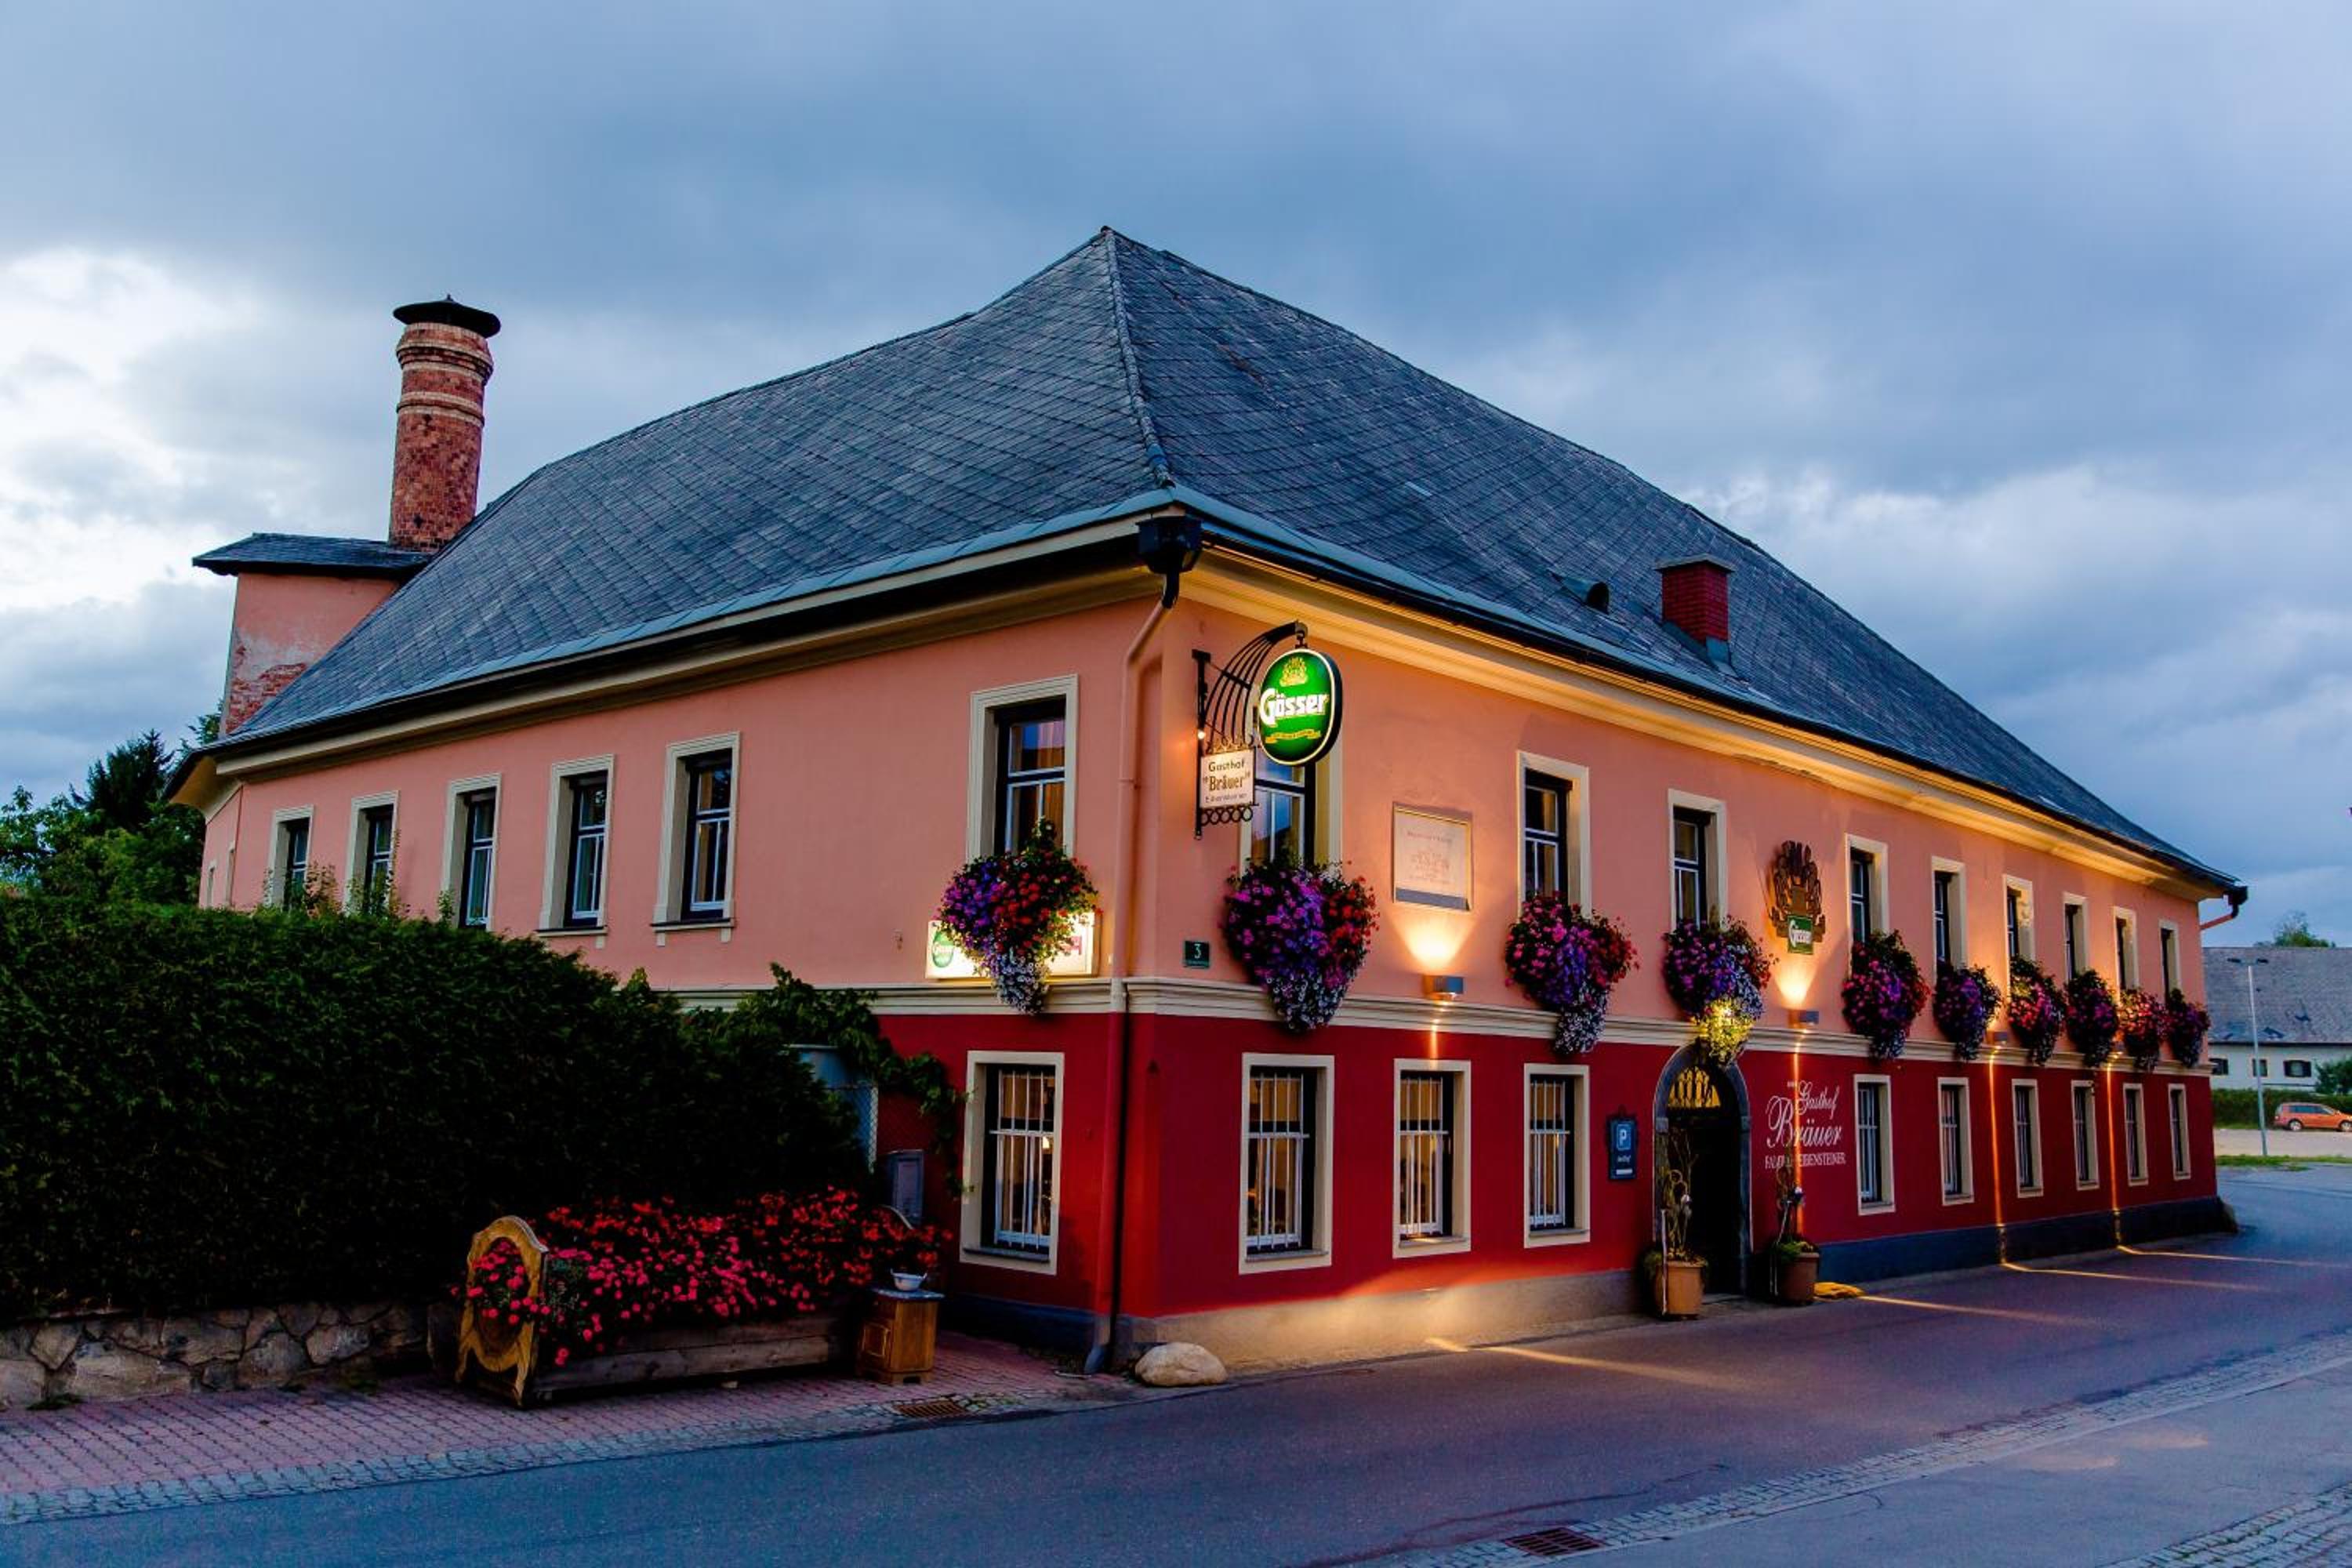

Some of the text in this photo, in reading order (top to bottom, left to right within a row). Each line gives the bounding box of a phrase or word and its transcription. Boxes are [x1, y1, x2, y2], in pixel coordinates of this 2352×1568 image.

[1260, 688, 1330, 728] Gösser
[1208, 758, 1244, 772] Gasthof
[1194, 943, 1202, 959] 3
[1795, 1080, 1840, 1120] Gasthof
[1765, 1095, 1842, 1149] Bräuer
[1619, 1129, 1627, 1147] P
